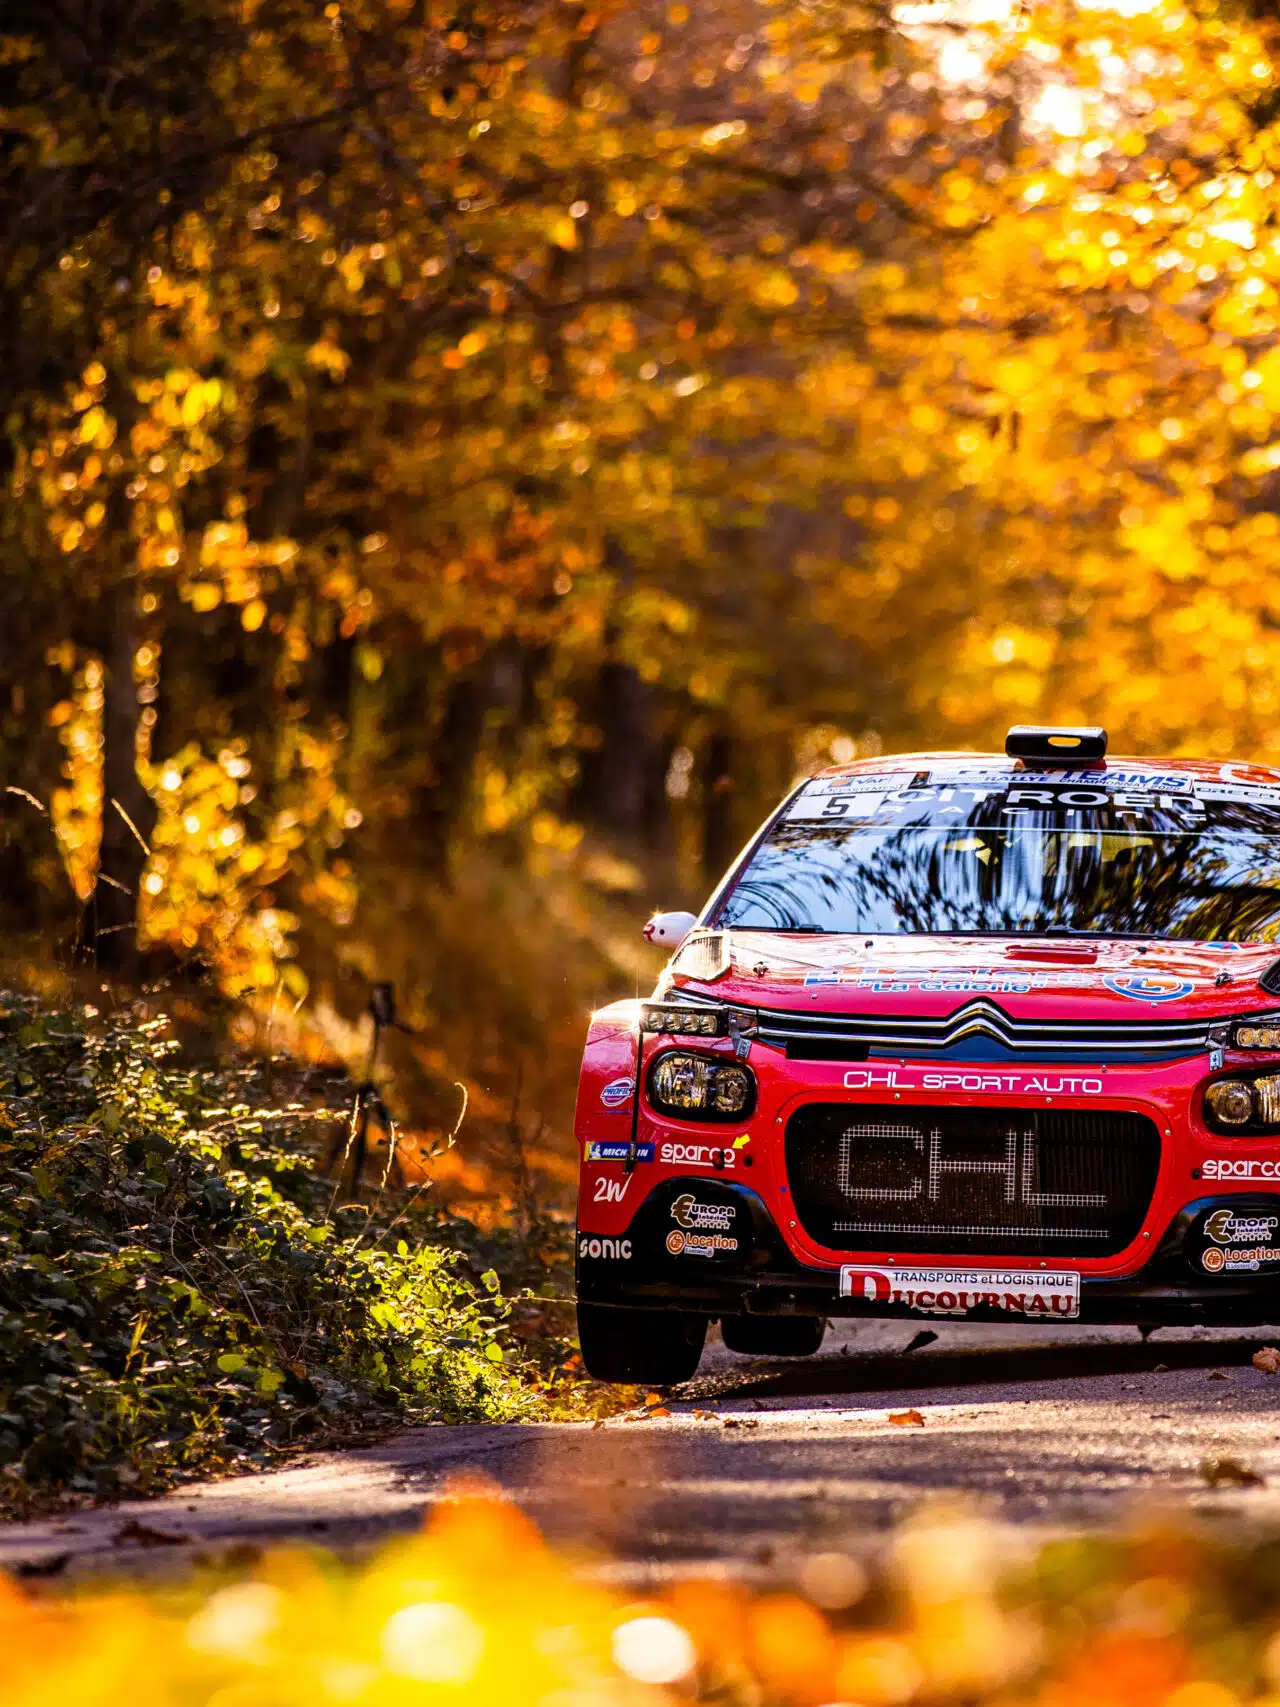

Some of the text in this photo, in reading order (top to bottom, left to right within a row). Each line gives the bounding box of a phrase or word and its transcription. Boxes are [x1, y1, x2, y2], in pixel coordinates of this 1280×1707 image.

[984, 775, 1050, 783] RALLYE
[1062, 770, 1188, 788] TEAMS
[821, 796, 856, 816] 5
[843, 1071, 1103, 1094] CHL SPORT AUTO
[838, 1125, 1108, 1207] CHL
[593, 1173, 634, 1203] 2W
[686, 1232, 738, 1251] Location
[893, 1272, 1074, 1287] TRANSPORTS et LOGISTIQUE
